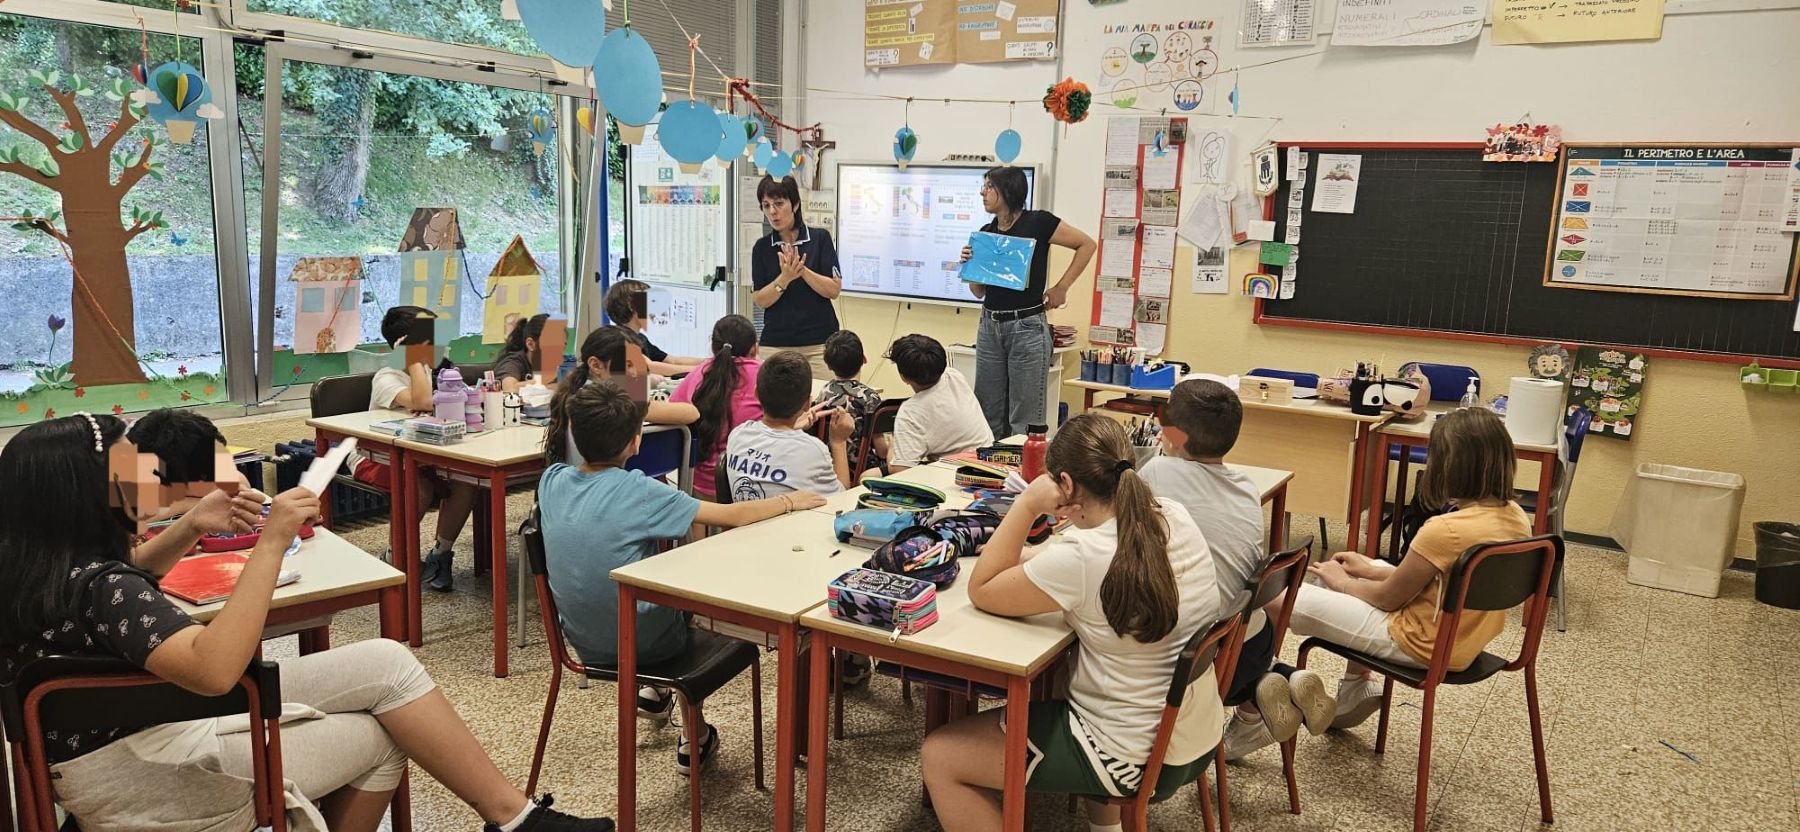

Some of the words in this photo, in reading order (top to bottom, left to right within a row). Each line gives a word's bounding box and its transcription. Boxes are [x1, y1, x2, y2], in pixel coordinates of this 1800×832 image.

[1601, 7, 1637, 15] ANTERIORE
[1339, 12, 1397, 23] NUMERALI
[1104, 25, 1113, 34] LA
[1132, 23, 1161, 33] MAPPA
[1178, 20, 1214, 31] CORAGGIO
[1624, 149, 1635, 158] IL
[1638, 149, 1694, 158] PERIMETRO
[1697, 149, 1703, 158] E
[1707, 149, 1745, 159] L'AREA
[747, 448, 772, 462] マリオ
[728, 454, 787, 483] MARIO
